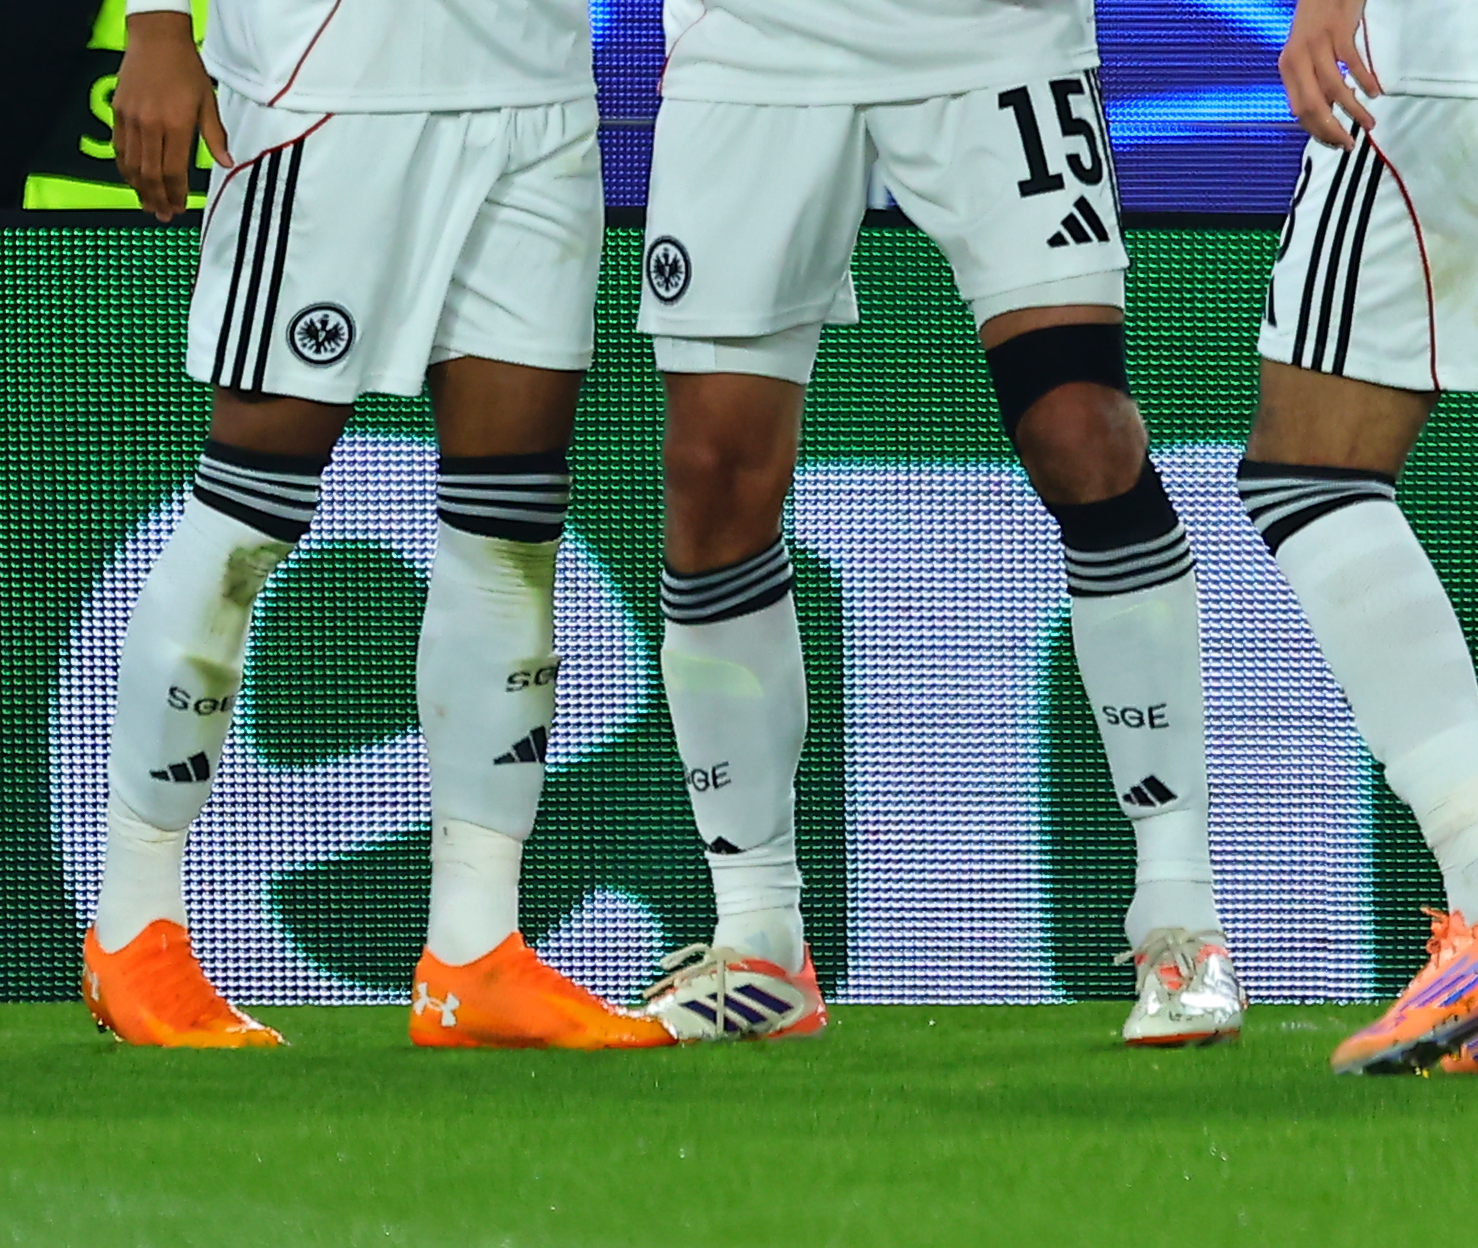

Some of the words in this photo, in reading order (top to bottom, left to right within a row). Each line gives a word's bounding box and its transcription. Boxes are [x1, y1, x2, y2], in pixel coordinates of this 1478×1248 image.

[998, 78, 1103, 198] 15
[1103, 702, 1169, 729] SGE
[687, 761, 731, 792] GE
